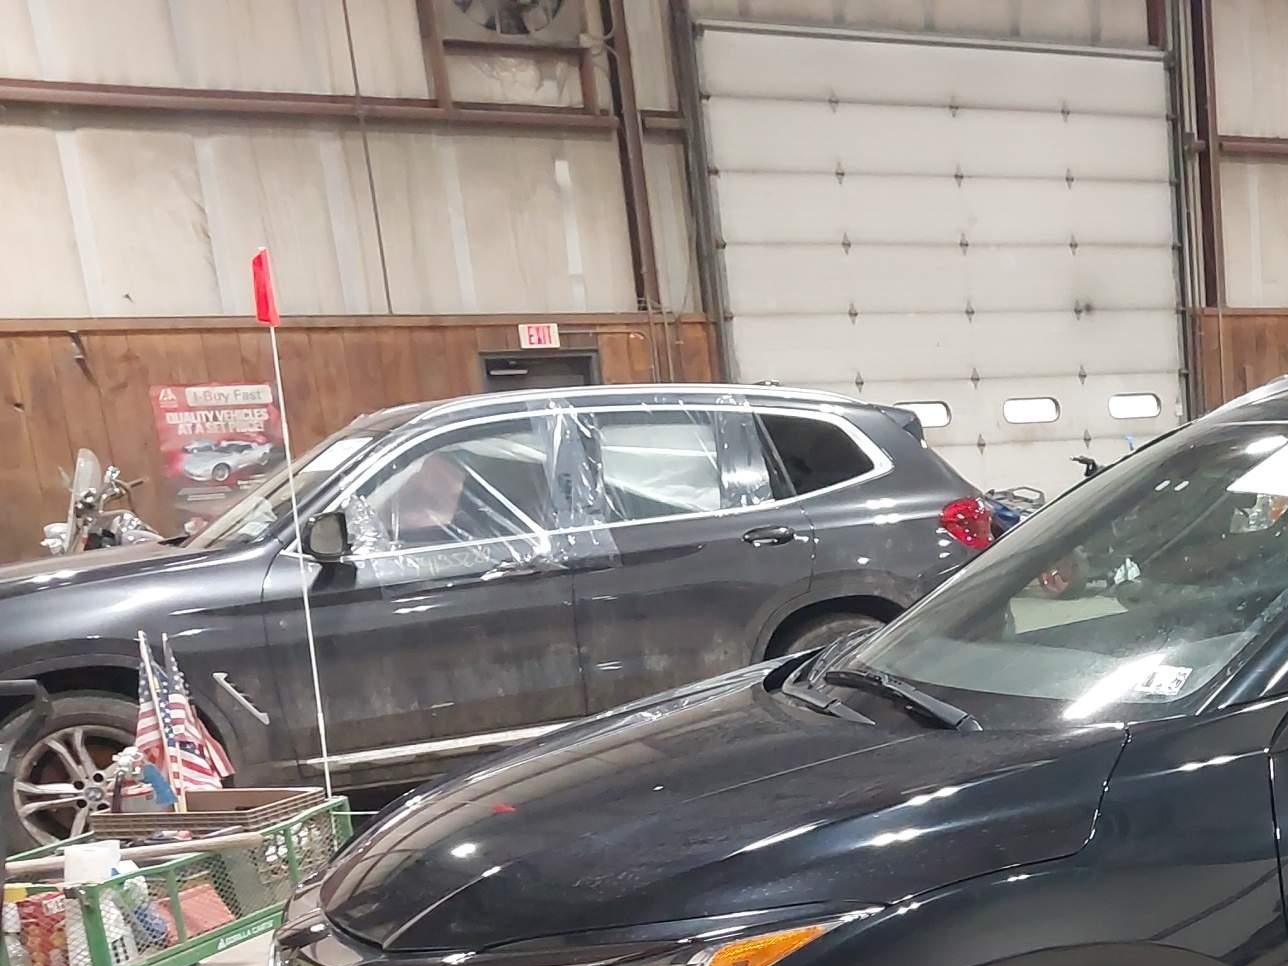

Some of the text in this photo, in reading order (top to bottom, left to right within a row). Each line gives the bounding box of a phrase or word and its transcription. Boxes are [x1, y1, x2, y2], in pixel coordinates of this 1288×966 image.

[527, 325, 552, 345] EXIT
[165, 408, 269, 424] QUALITY VEHICLES
[177, 423, 193, 435] AT
